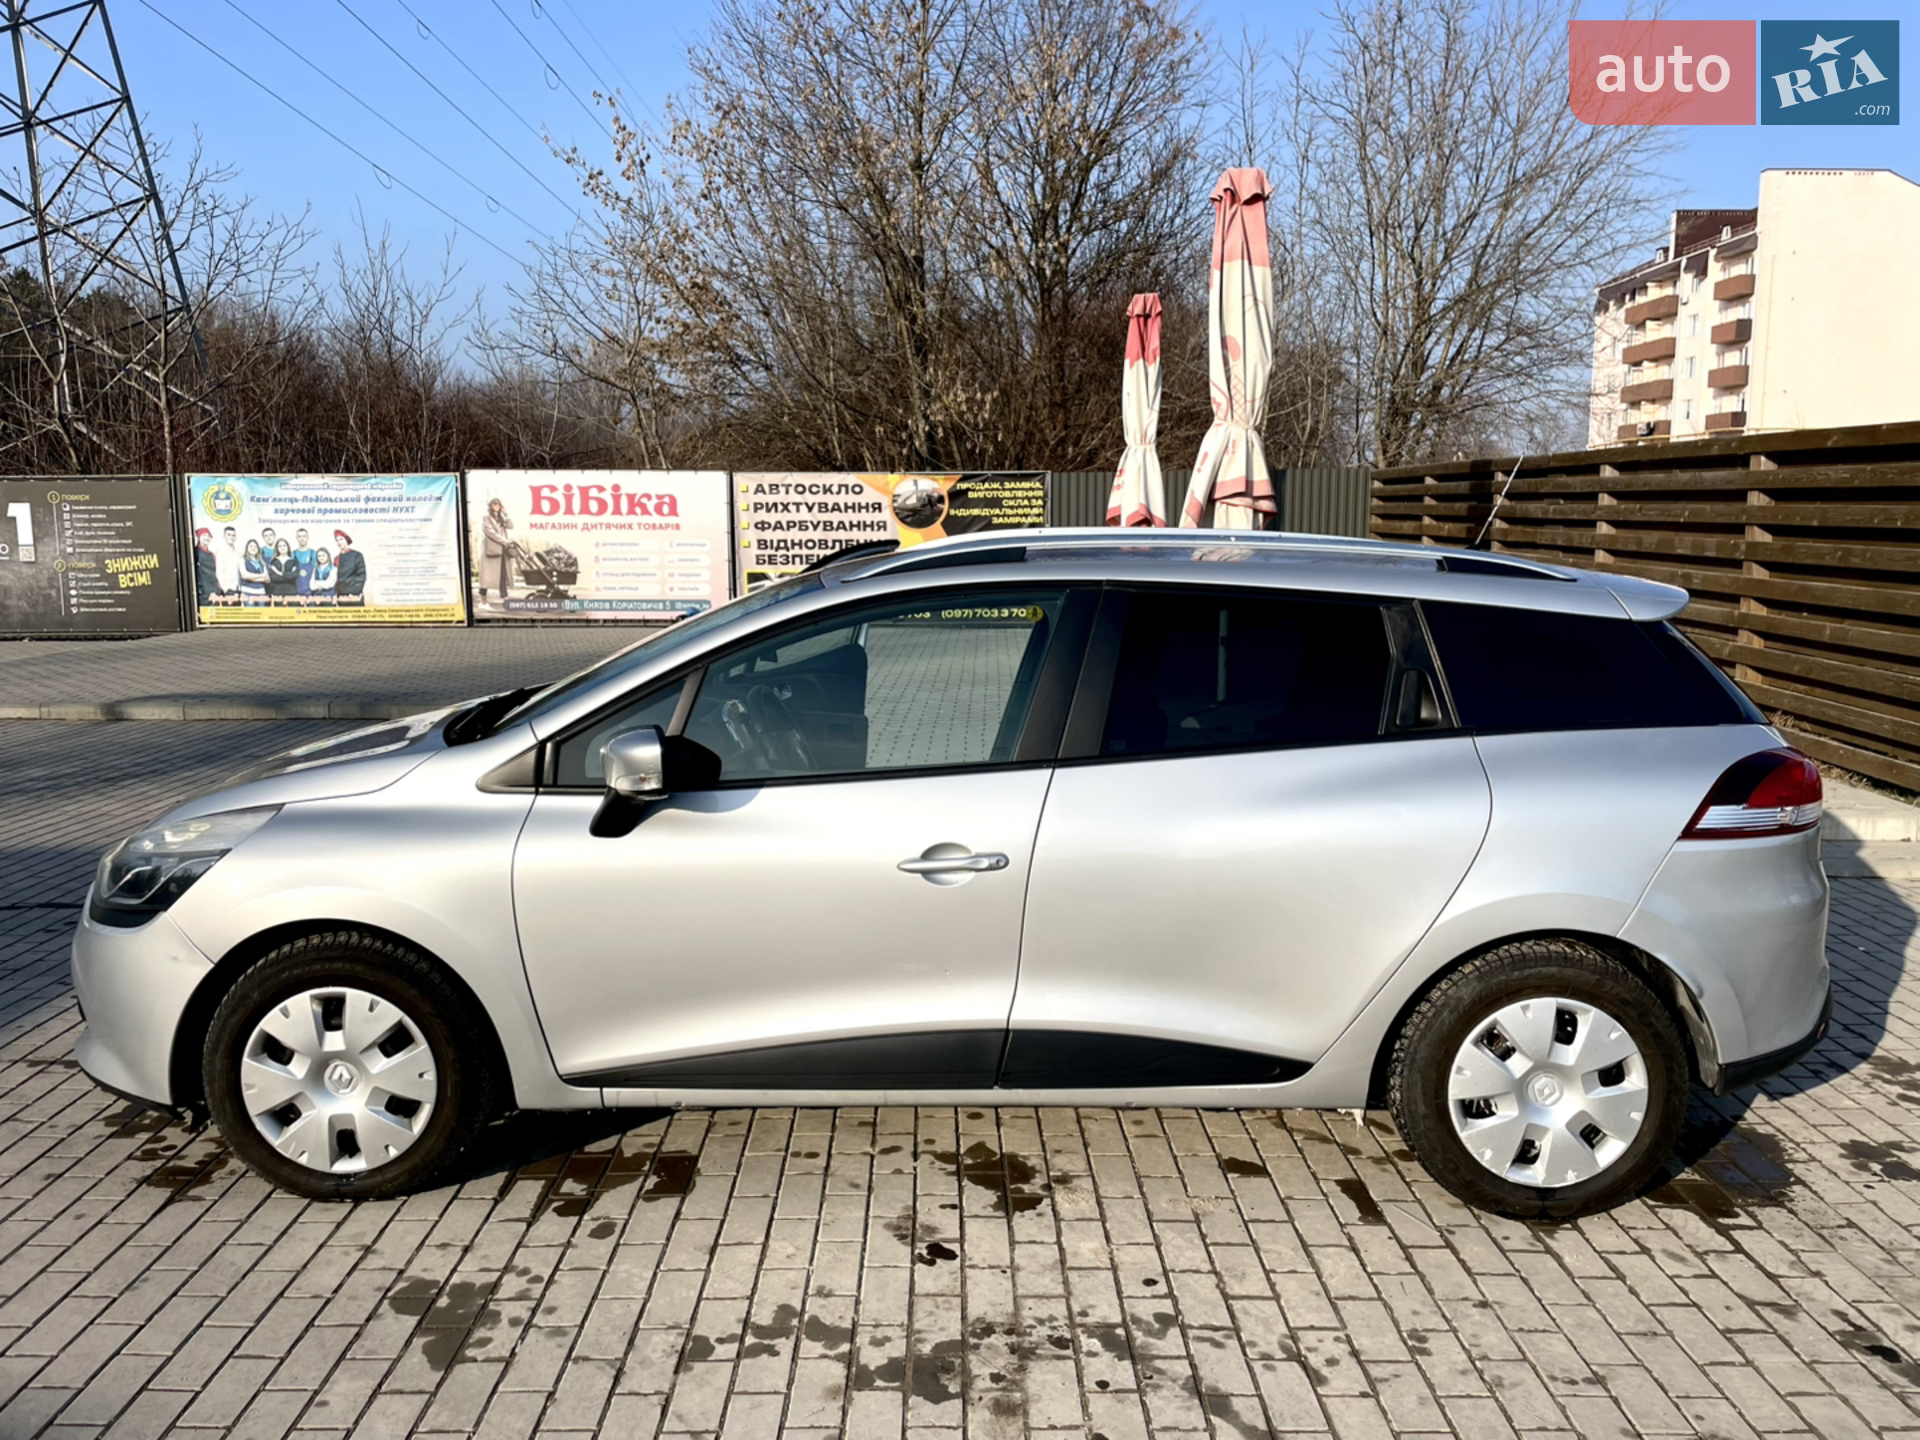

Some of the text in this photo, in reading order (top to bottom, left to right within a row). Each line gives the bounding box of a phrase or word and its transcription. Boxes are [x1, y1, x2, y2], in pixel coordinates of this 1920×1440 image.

[753, 483, 864, 495] АВТОСКЛО
[528, 483, 680, 518] БіБіка
[753, 502, 882, 513] РИХТУВАННЯ
[950, 508, 1043, 516] ІНДИВІДУАЛЬНИМИ
[529, 522, 681, 533] МАГАЗИН ДИТЯЧИХ ТОВАРІВ
[754, 520, 887, 532] ФАРБУВАННЯ
[757, 539, 882, 552] ВІДНОВЛЕ
[104, 553, 159, 574] ЗНИЖКИ
[118, 570, 152, 589] ВСІМ!
[941, 608, 973, 619] (097)
[974, 608, 998, 618] 703
[1000, 608, 1009, 617] 3
